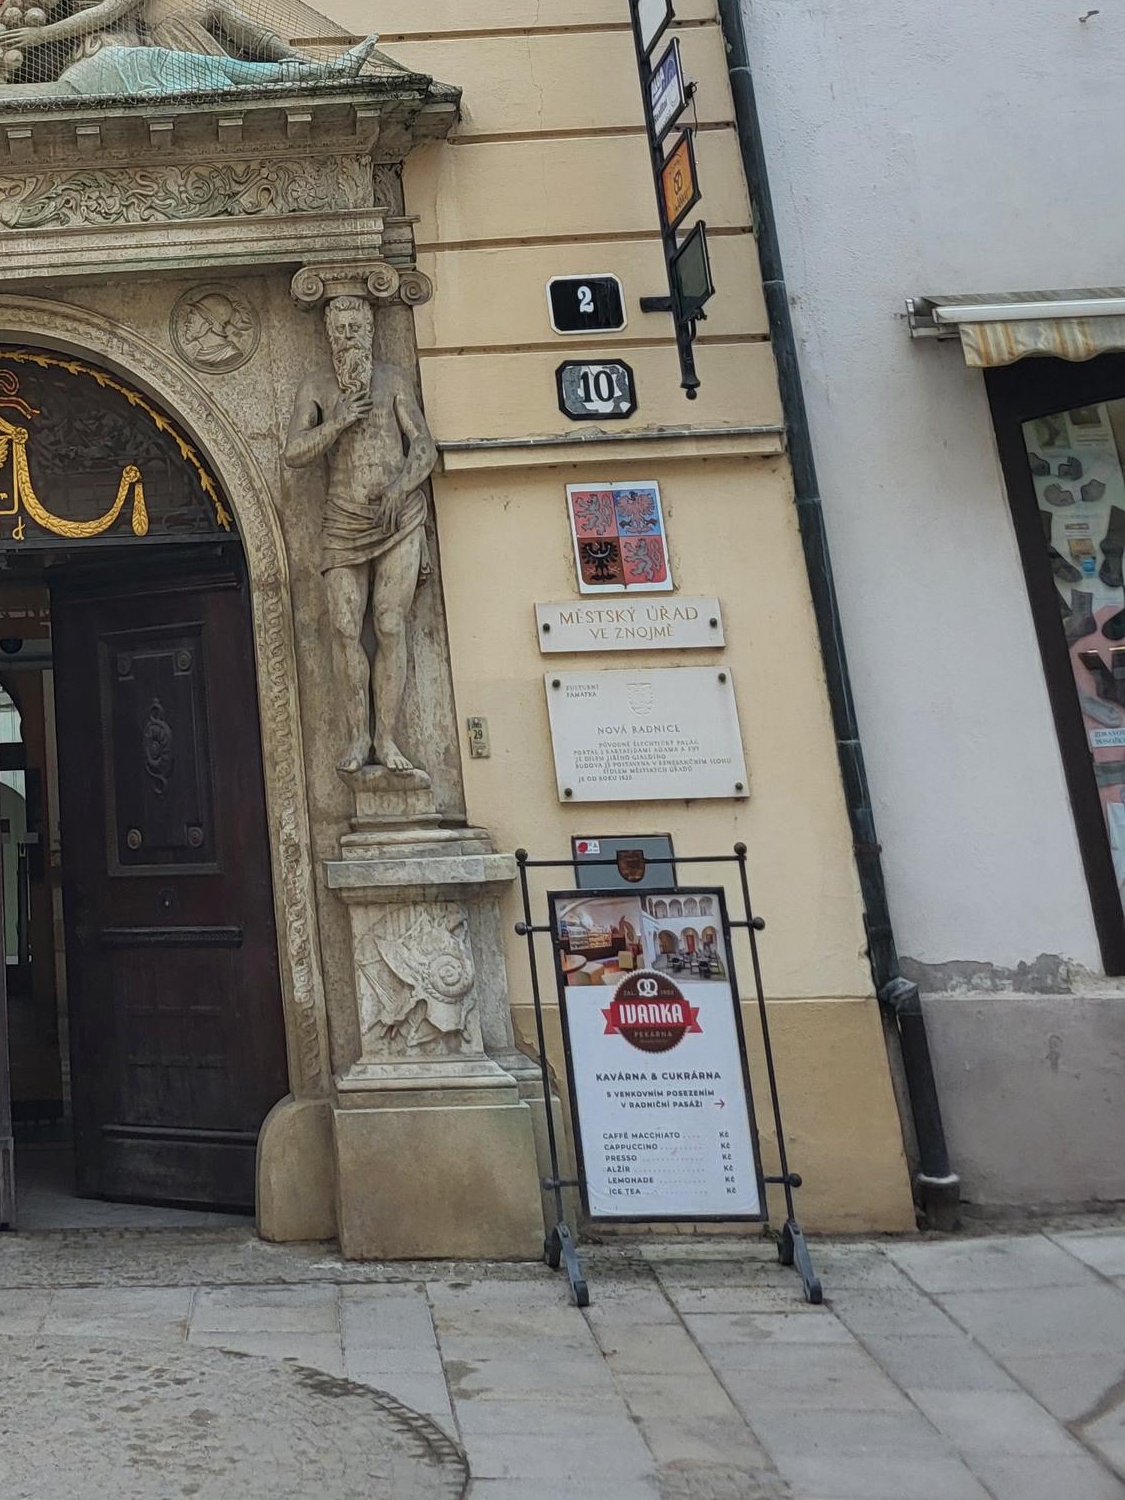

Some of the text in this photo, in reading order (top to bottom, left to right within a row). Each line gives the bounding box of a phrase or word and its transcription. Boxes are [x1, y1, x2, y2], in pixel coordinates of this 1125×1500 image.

[577, 285, 594, 313] 2
[580, 370, 615, 403] 10
[559, 605, 699, 625] MĚSTSKÝ ÚŘAD
[589, 623, 674, 641] VE ZNOJMĚ
[597, 724, 681, 735] NOVÁ RADNICE
[618, 1003, 684, 1024] IVANKA
[595, 1070, 721, 1082] KAVÁRNA & CUKRÁRNA
[614, 1089, 664, 1098] VENKOVNÍM
[666, 1088, 715, 1097] POSEZENÍM
[629, 1100, 670, 1109] RADNIČNÍ
[631, 1131, 680, 1139] MACCHIATO
[604, 1143, 658, 1151] CAPPUCCINO
[605, 1154, 637, 1162] PRESSO
[607, 1176, 654, 1184] LEMONADE
